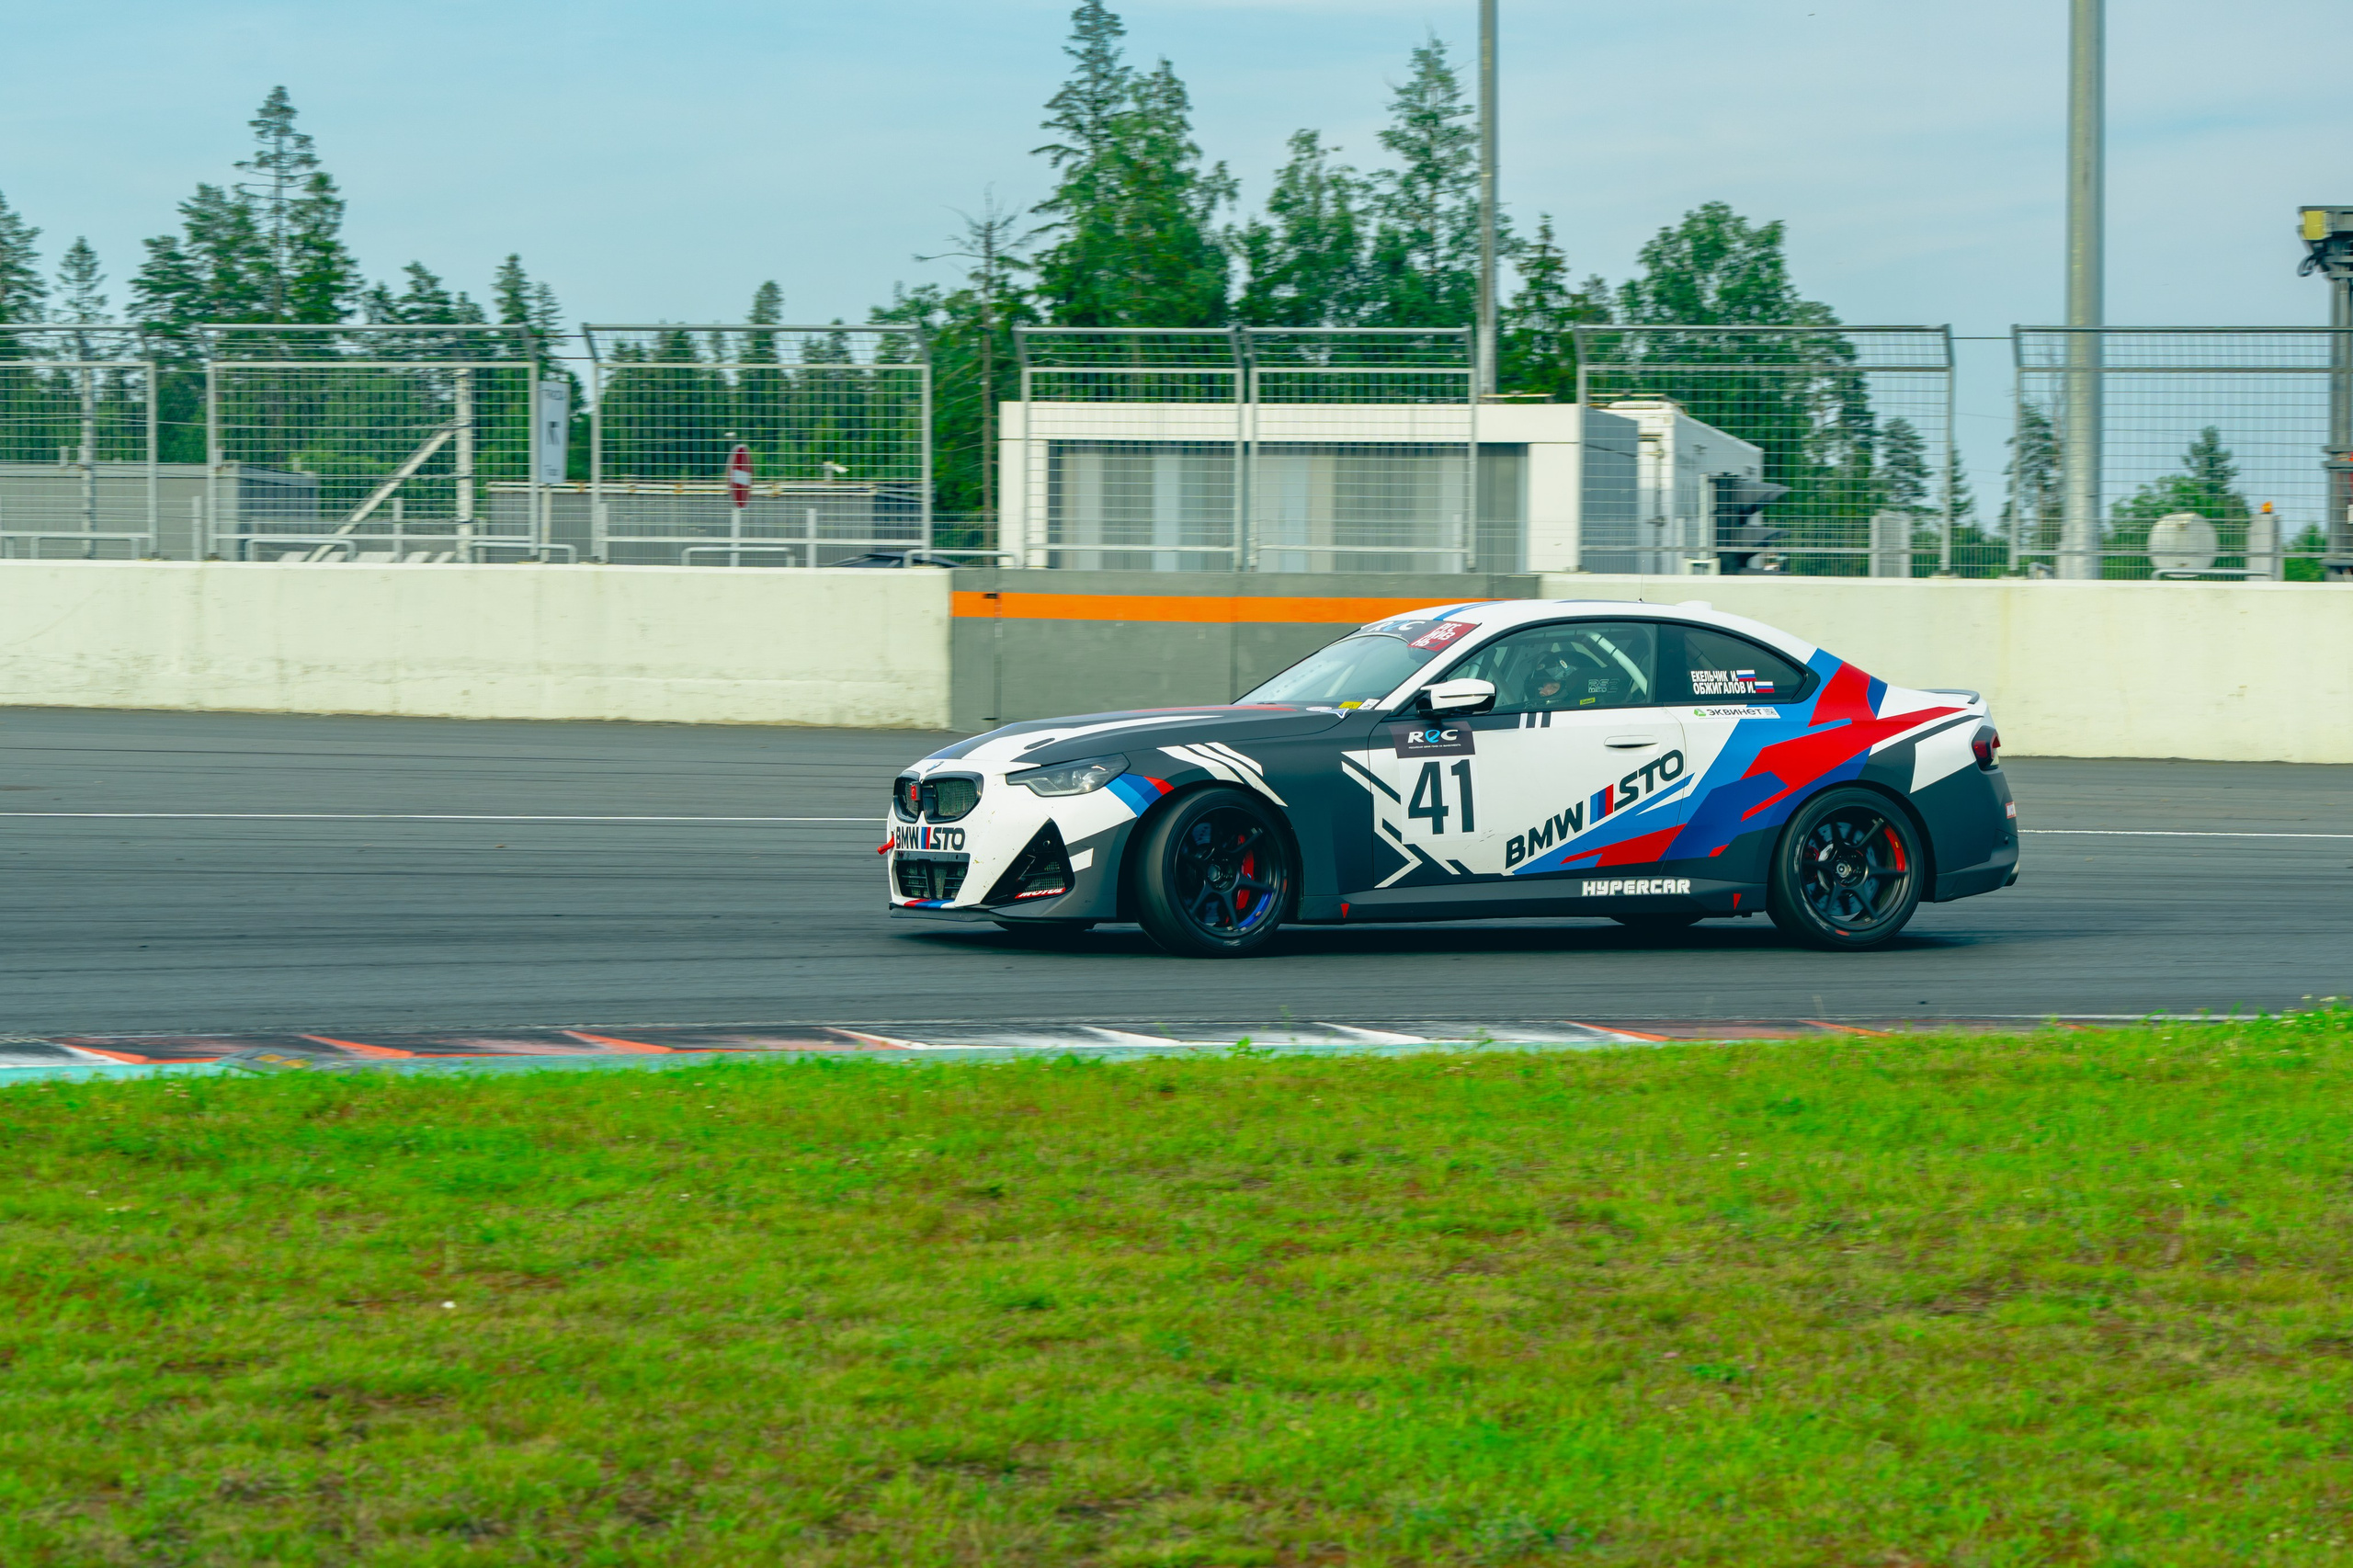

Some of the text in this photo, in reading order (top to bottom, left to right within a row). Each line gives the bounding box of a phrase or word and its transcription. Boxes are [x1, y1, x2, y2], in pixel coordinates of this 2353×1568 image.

[1690, 671, 1729, 683] ЕКЕЛЬЧИК
[1692, 681, 1746, 695] ОБЖИГАЛОВ
[1407, 758, 1475, 835] 41
[1505, 749, 1685, 869] BMW STO
[895, 825, 966, 851] BMW STO
[1017, 887, 1063, 898] MOTUL
[1581, 879, 1691, 897] HYPERCAR
